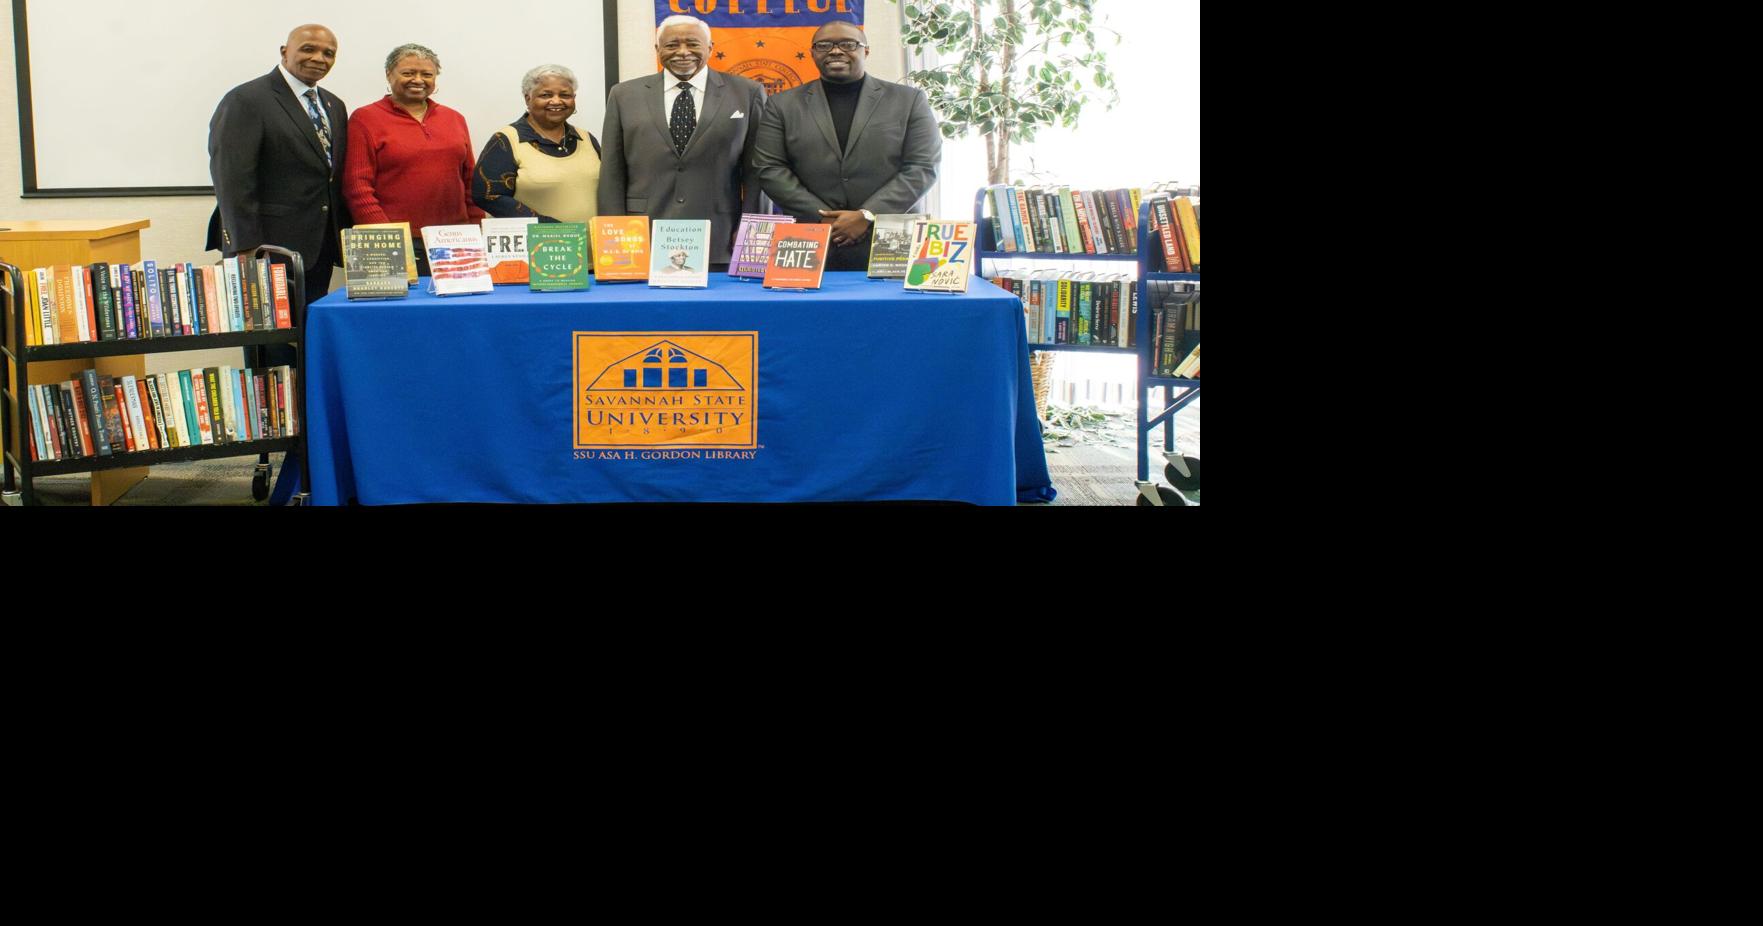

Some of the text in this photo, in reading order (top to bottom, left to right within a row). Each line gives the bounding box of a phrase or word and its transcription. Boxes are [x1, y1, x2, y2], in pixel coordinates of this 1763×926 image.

[916, 222, 968, 243] TRUE
[1157, 204, 1176, 256] UNSETTLED LAND
[487, 236, 528, 252] FRE
[778, 240, 819, 249] COMBATING
[929, 240, 968, 263] BIZ
[775, 250, 816, 268] HATE
[146, 262, 156, 294] SOLITO
[274, 266, 287, 299] FORMIDABLE
[57, 280, 66, 312] DOMINION
[585, 394, 746, 405] SAVANNAH STATE
[586, 410, 744, 425] UNIVERSITY
[573, 450, 757, 460] SSU ASA H. GORDON LIBRARY
